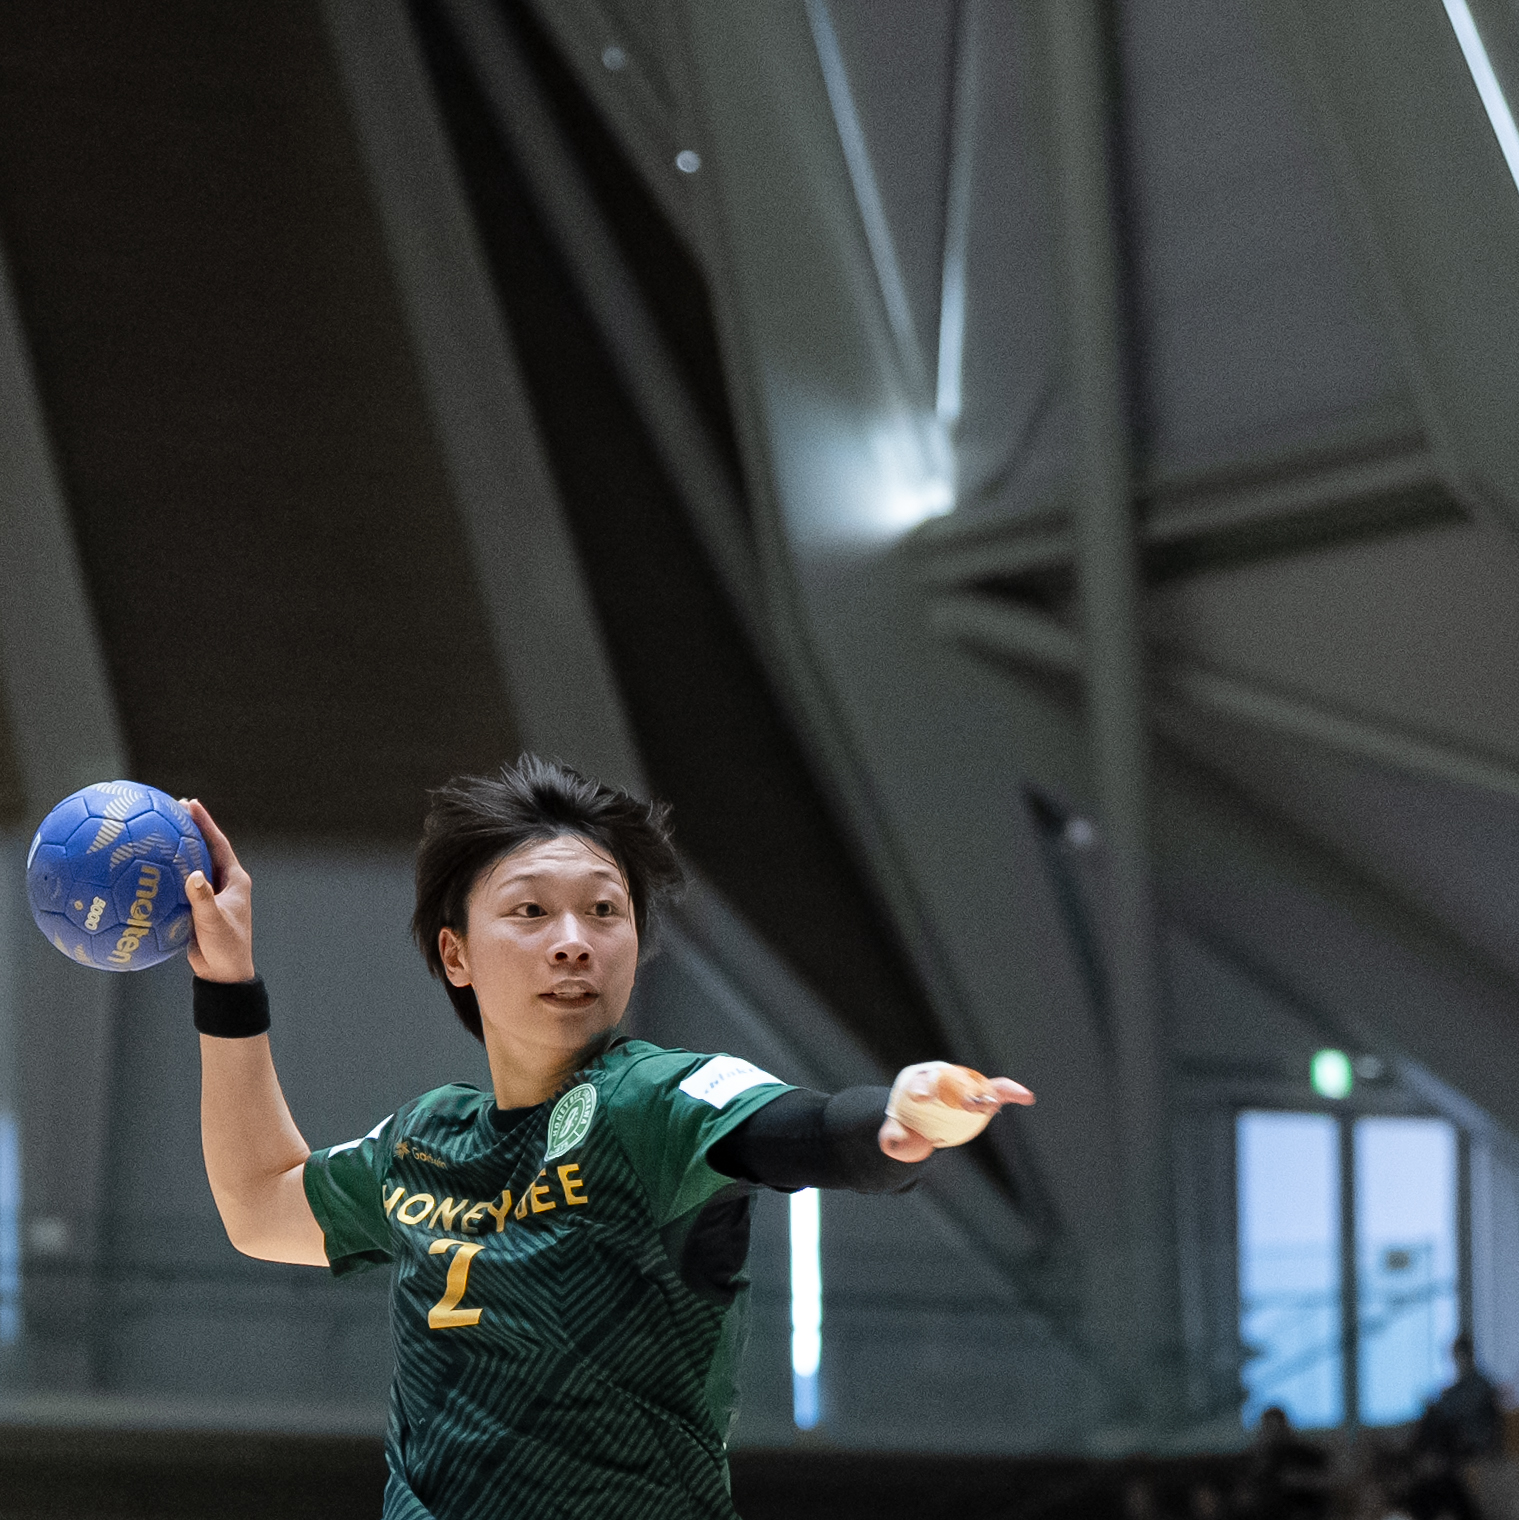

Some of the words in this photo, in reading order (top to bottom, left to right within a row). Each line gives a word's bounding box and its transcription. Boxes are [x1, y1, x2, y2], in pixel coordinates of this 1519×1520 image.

[84, 896, 107, 931] 5000
[107, 865, 161, 963] molten
[428, 1238, 485, 1330] 2
